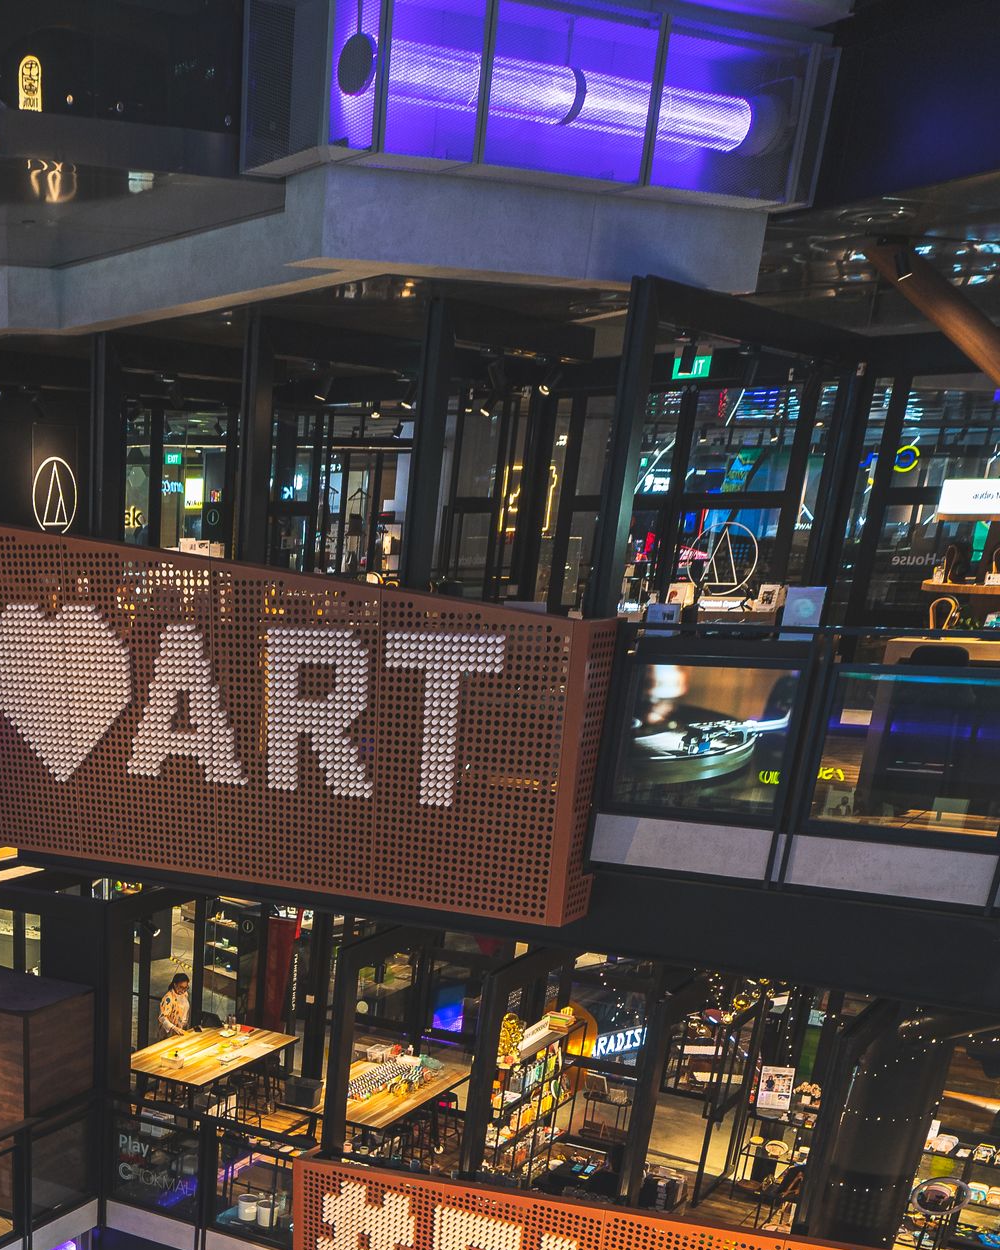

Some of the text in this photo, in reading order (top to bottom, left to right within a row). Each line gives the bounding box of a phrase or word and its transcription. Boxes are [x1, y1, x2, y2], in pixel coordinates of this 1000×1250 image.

[167, 454, 178, 464] EXIT
[126, 622, 507, 808] ART
[118, 1134, 150, 1158] Play
